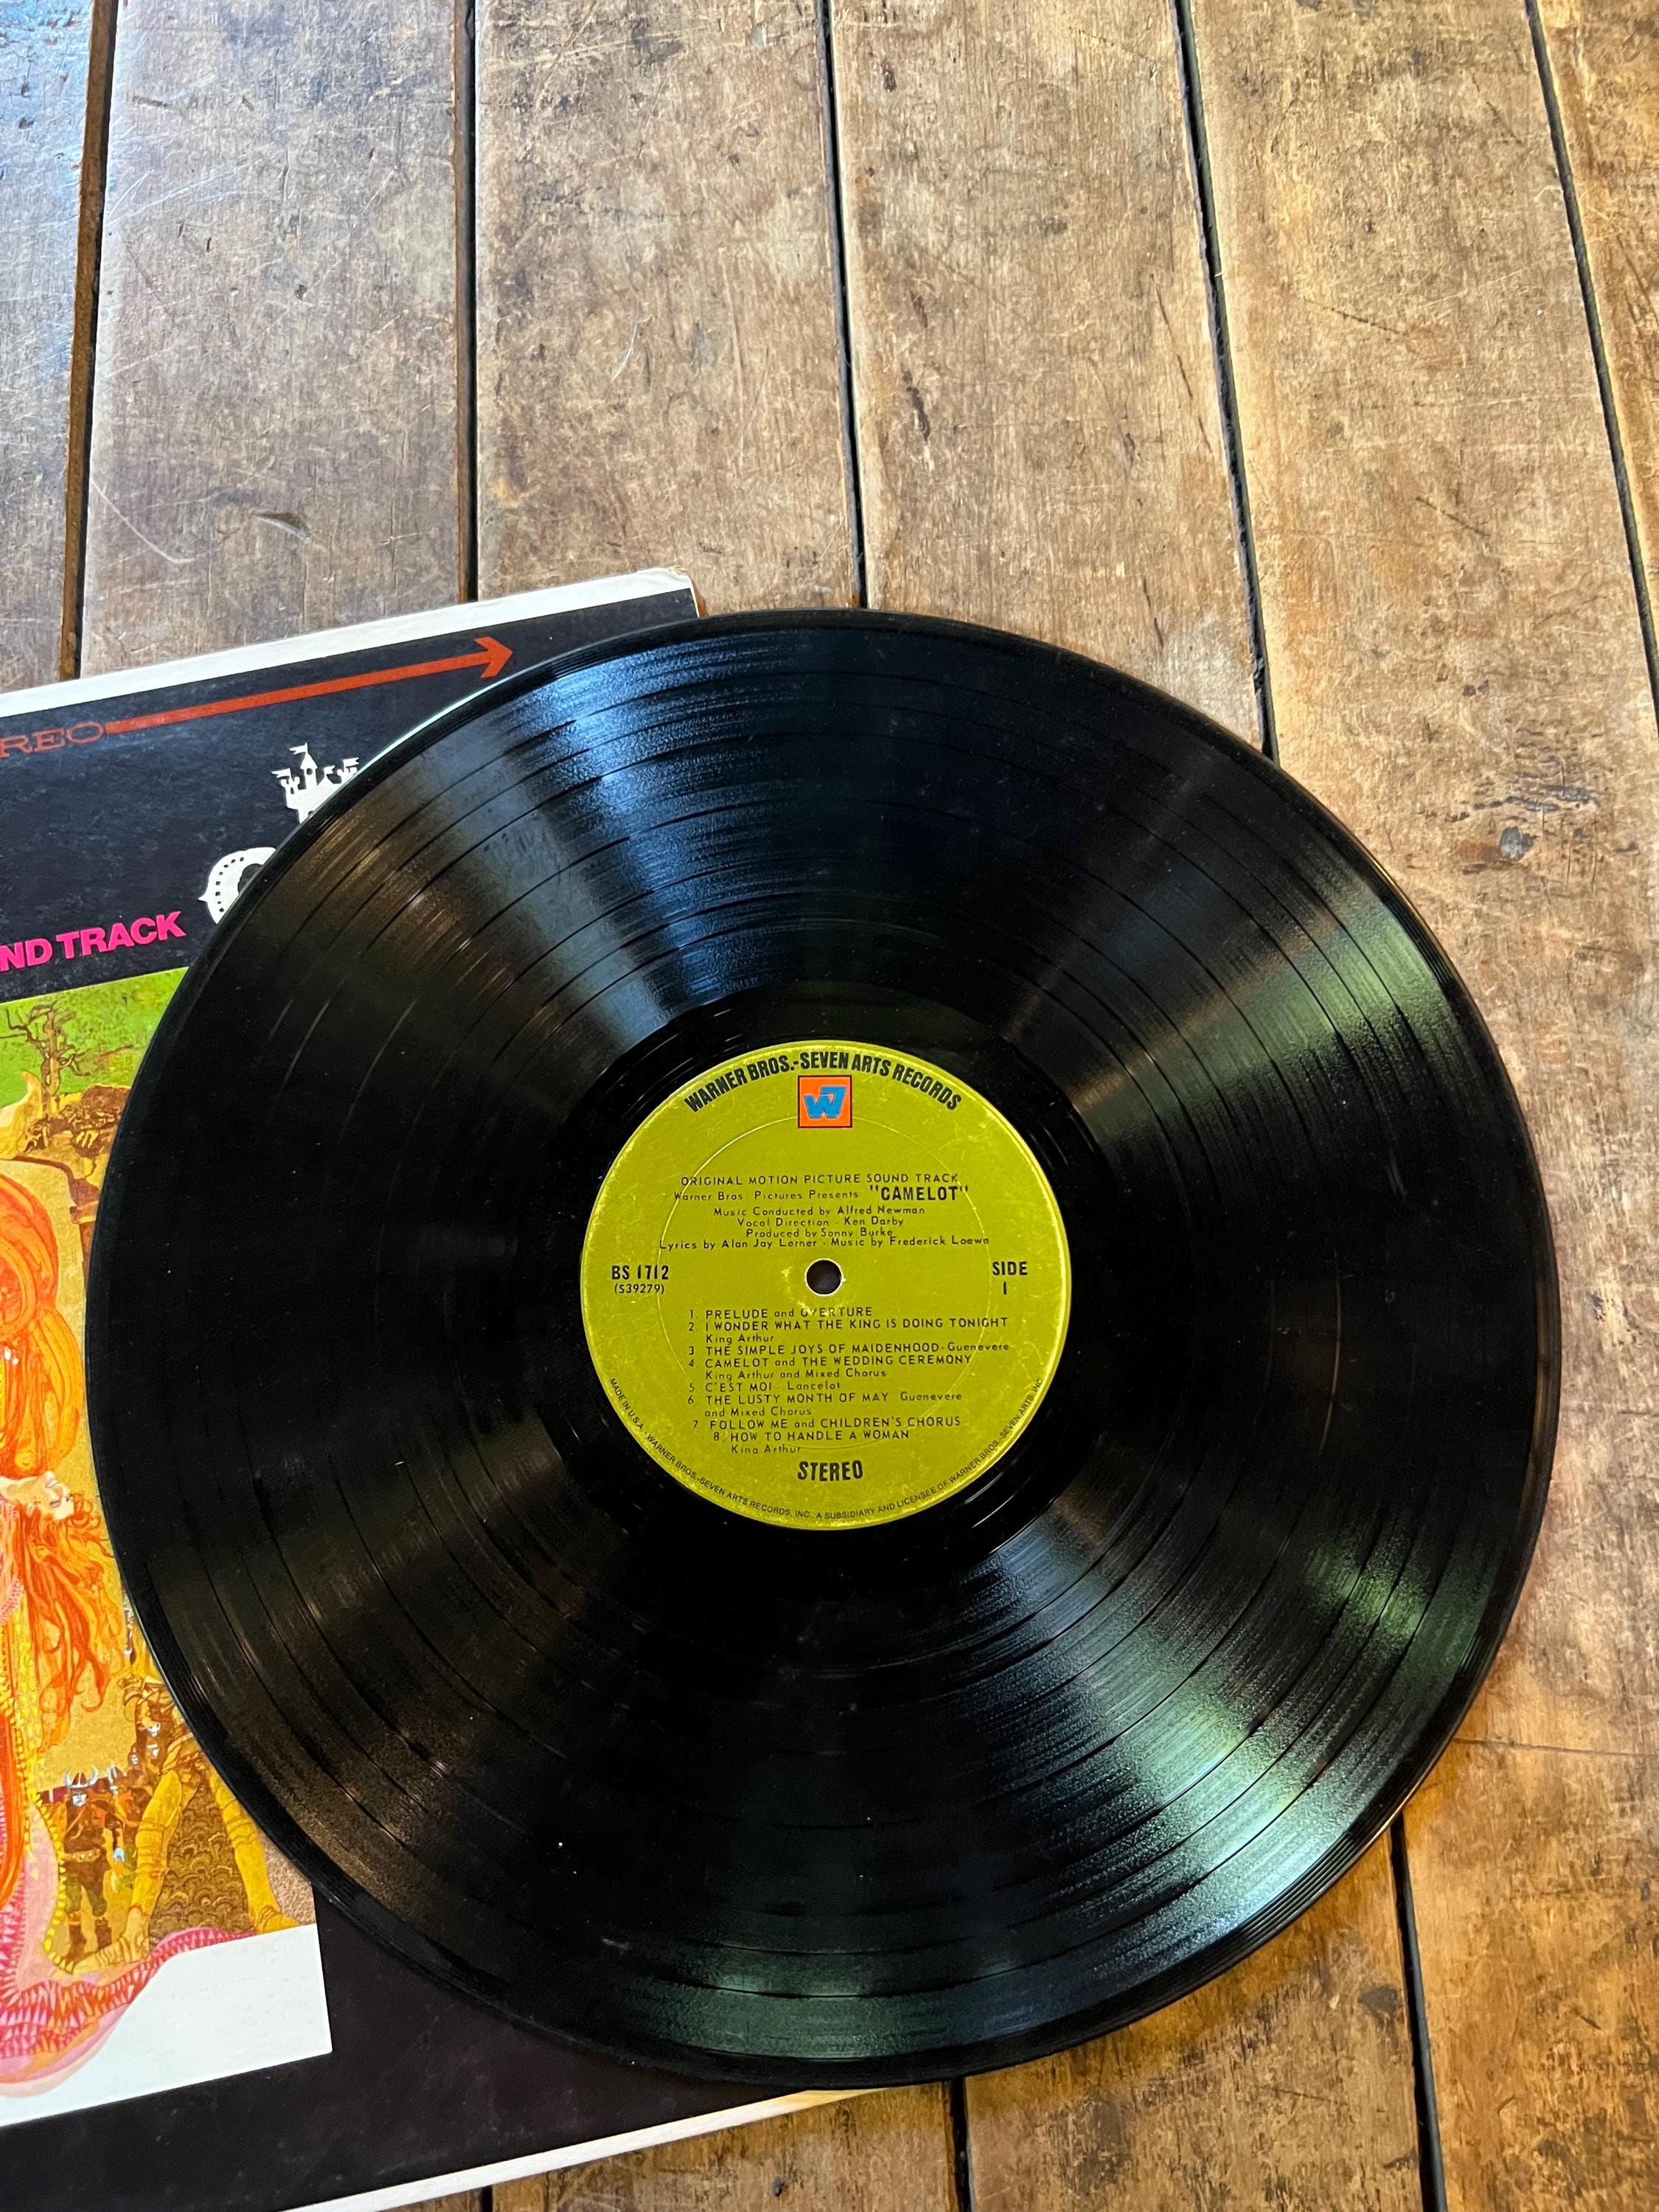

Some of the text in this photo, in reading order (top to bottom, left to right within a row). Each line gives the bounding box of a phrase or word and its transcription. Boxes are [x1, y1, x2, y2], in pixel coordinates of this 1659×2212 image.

[55, 911, 187, 959] TRACK
[684, 1068, 748, 1113] WARNER
[852, 1054, 891, 1077] ARTS
[891, 1062, 961, 1110] RECORDS
[681, 1173, 958, 1186] ORIGINAL MOTION PICTURE SOUND TRACK
[674, 1192, 712, 1201] Warner
[754, 1191, 802, 1200] Pictures
[809, 1190, 859, 1200] Presents
[869, 1185, 968, 1201] "CAMELOT"
[714, 1208, 746, 1217] Music
[753, 1206, 813, 1217] Conducted
[837, 1206, 872, 1214] Alfred
[877, 1206, 925, 1214] Newman
[737, 1218, 770, 1228] Vocal
[776, 1217, 829, 1227] Direction
[844, 1217, 865, 1225] Ken
[872, 1217, 904, 1227] Darby
[746, 1227, 893, 1239] Produced by Sonny Burke
[659, 1239, 698, 1251] Lyrics
[703, 1239, 716, 1251] by
[721, 1239, 748, 1248] Alan
[754, 1239, 773, 1250] Jay
[779, 1238, 817, 1248] Lerner
[831, 1237, 864, 1247] Music
[871, 1237, 883, 1248] by
[889, 1235, 946, 1246] Frederick
[611, 1265, 669, 1280] BS 1712
[992, 1261, 1028, 1276] SIDE
[614, 1283, 665, 1295] (S39279)
[706, 1309, 768, 1320] PRELUDE
[774, 1308, 795, 1318] and
[800, 1307, 872, 1318] OVERTURE
[714, 1321, 768, 1332] WONDER
[775, 1319, 810, 1330] WHAT
[817, 1319, 843, 1329] THE
[849, 1318, 880, 1329] KING
[886, 1318, 897, 1329] IS
[902, 1318, 944, 1328] DOING
[949, 1317, 1009, 1328] TONIGHT
[706, 1333, 774, 1345] King Arthur
[706, 1346, 731, 1357] THE
[737, 1345, 785, 1356] SIMPLE
[790, 1344, 824, 1354] JOYS
[829, 1343, 846, 1354] OF
[705, 1357, 769, 1368] CAMELOT
[774, 1357, 795, 1366] and
[801, 1356, 827, 1366] THE
[833, 1355, 894, 1366] WEDDING
[898, 1354, 973, 1365] CEREMONY
[706, 1368, 887, 1382] King Arthur and Mixed Chorus
[705, 1382, 742, 1393] C'EST
[749, 1381, 772, 1391] MOI
[787, 1380, 841, 1391] Lancelot
[706, 1394, 731, 1405] THE
[738, 1394, 781, 1405] LUSTY
[786, 1392, 832, 1403] MONTH
[838, 1392, 857, 1403] OF
[862, 1391, 889, 1402] MAY
[900, 1391, 963, 1402] Guenevere
[704, 1406, 813, 1417] and Mixed Chorus
[710, 1419, 765, 1430] FOLLOW
[771, 1419, 788, 1429] ME
[794, 1418, 815, 1428] and
[820, 1416, 902, 1428] CHILDREN'S
[907, 1416, 961, 1427] CHORUS
[730, 1431, 758, 1442] HOW
[765, 1431, 782, 1441] TO
[787, 1430, 843, 1441] HANDLE
[849, 1431, 858, 1440] A
[863, 1430, 910, 1439] WOMAN
[610, 1377, 626, 1401] MADE
[622, 1400, 631, 1411] IN
[647, 1433, 676, 1464] WARNER
[726, 1491, 749, 1506] ARTS
[824, 1506, 875, 1520] SUBSIDIARY
[877, 1503, 896, 1513] AND
[897, 1486, 937, 1507] LICENSEE
[937, 1480, 949, 1491] OF
[948, 1457, 981, 1484] WARNER
[764, 1443, 801, 1453] Arthur
[797, 1459, 864, 1482] STEREO
